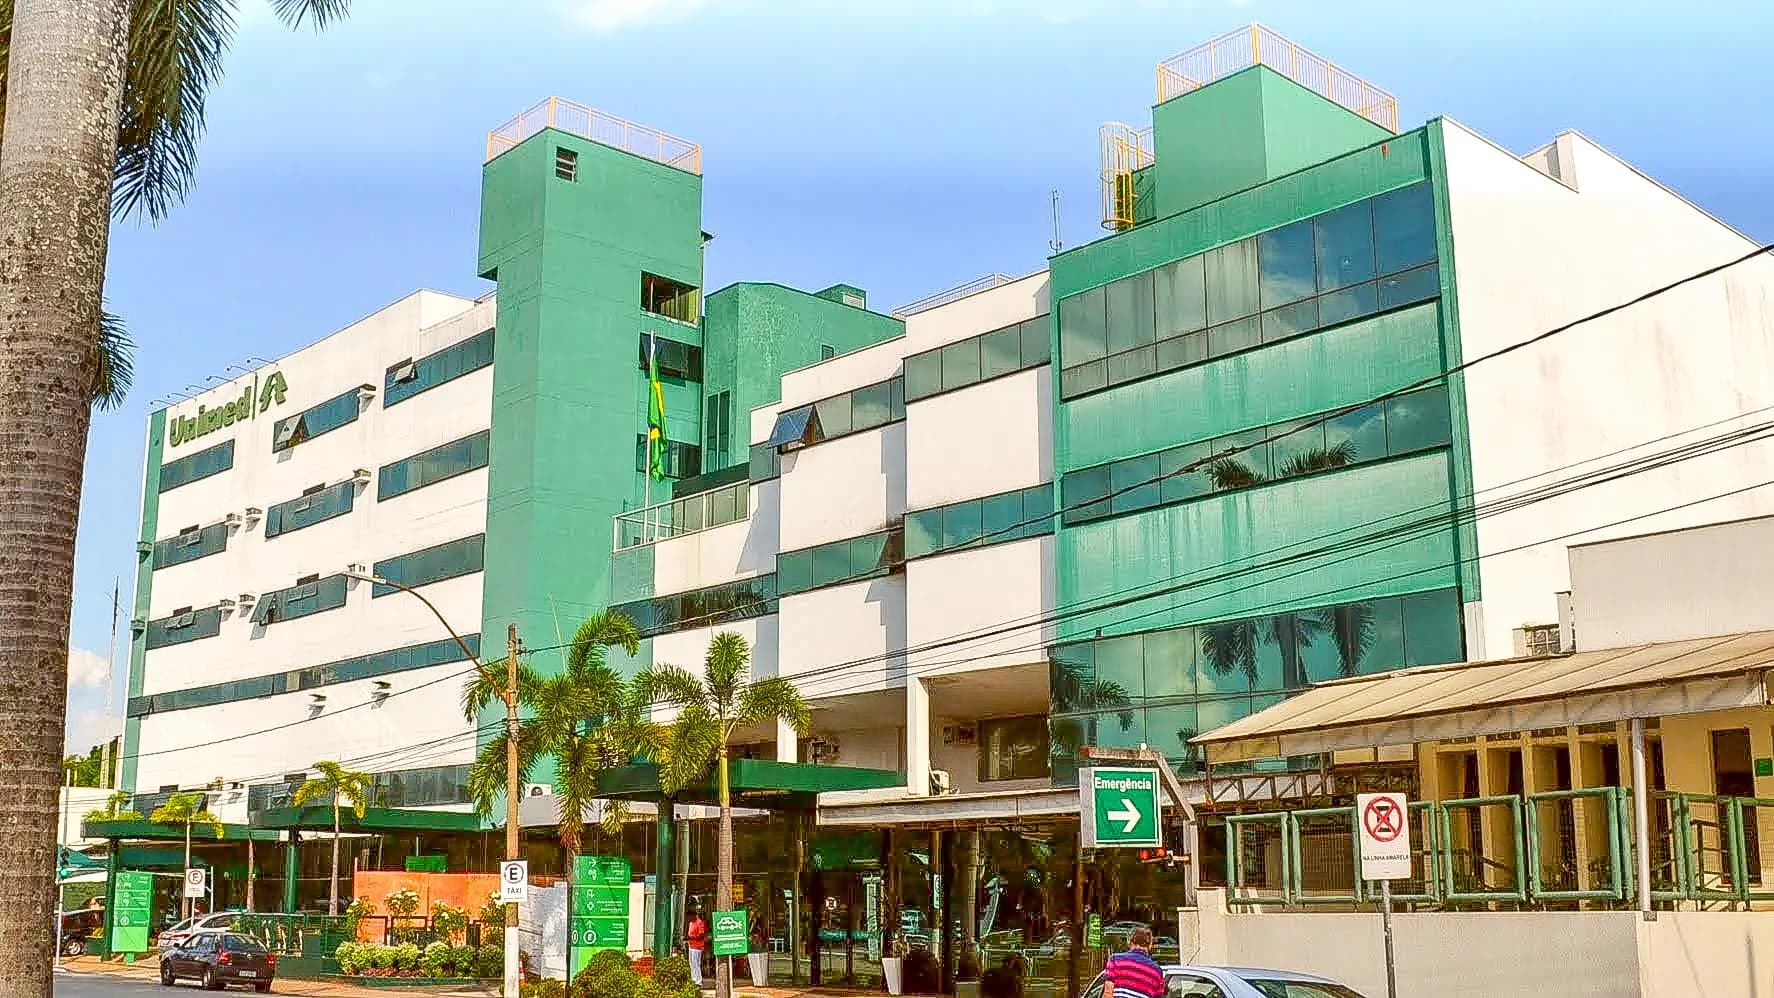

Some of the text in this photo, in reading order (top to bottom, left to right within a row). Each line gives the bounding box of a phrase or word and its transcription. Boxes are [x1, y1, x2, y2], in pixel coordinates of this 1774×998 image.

[169, 386, 252, 447] Unimed
[1094, 776, 1152, 793] Emergência
[509, 867, 518, 880] E
